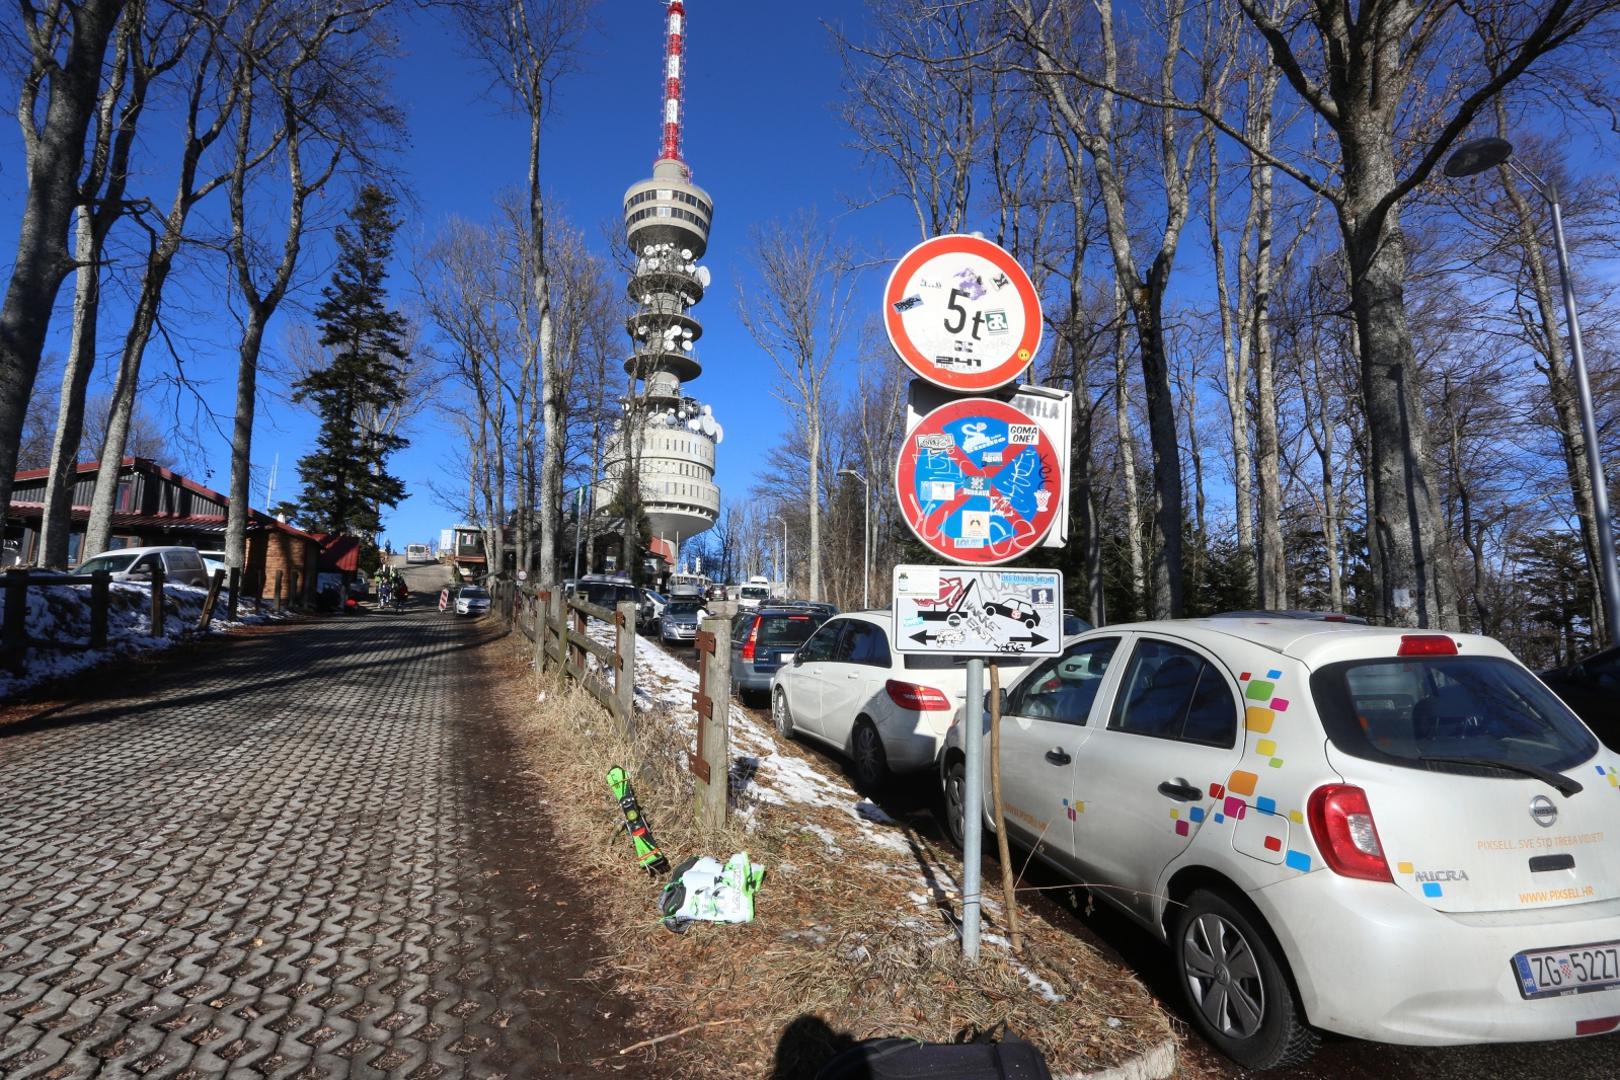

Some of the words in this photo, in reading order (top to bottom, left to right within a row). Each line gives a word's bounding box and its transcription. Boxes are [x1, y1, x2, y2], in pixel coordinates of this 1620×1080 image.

[944, 288, 970, 334] 5
[972, 311, 985, 340] t
[1010, 426, 1038, 435] GOMA
[1012, 434, 1035, 443] ONE!
[1415, 870, 1469, 882] MICRA
[1519, 886, 1594, 903] WWW.PIXSELL.HR
[1531, 956, 1562, 988] ZG
[1569, 949, 1619, 982] 5227
[1523, 978, 1535, 988] HR
